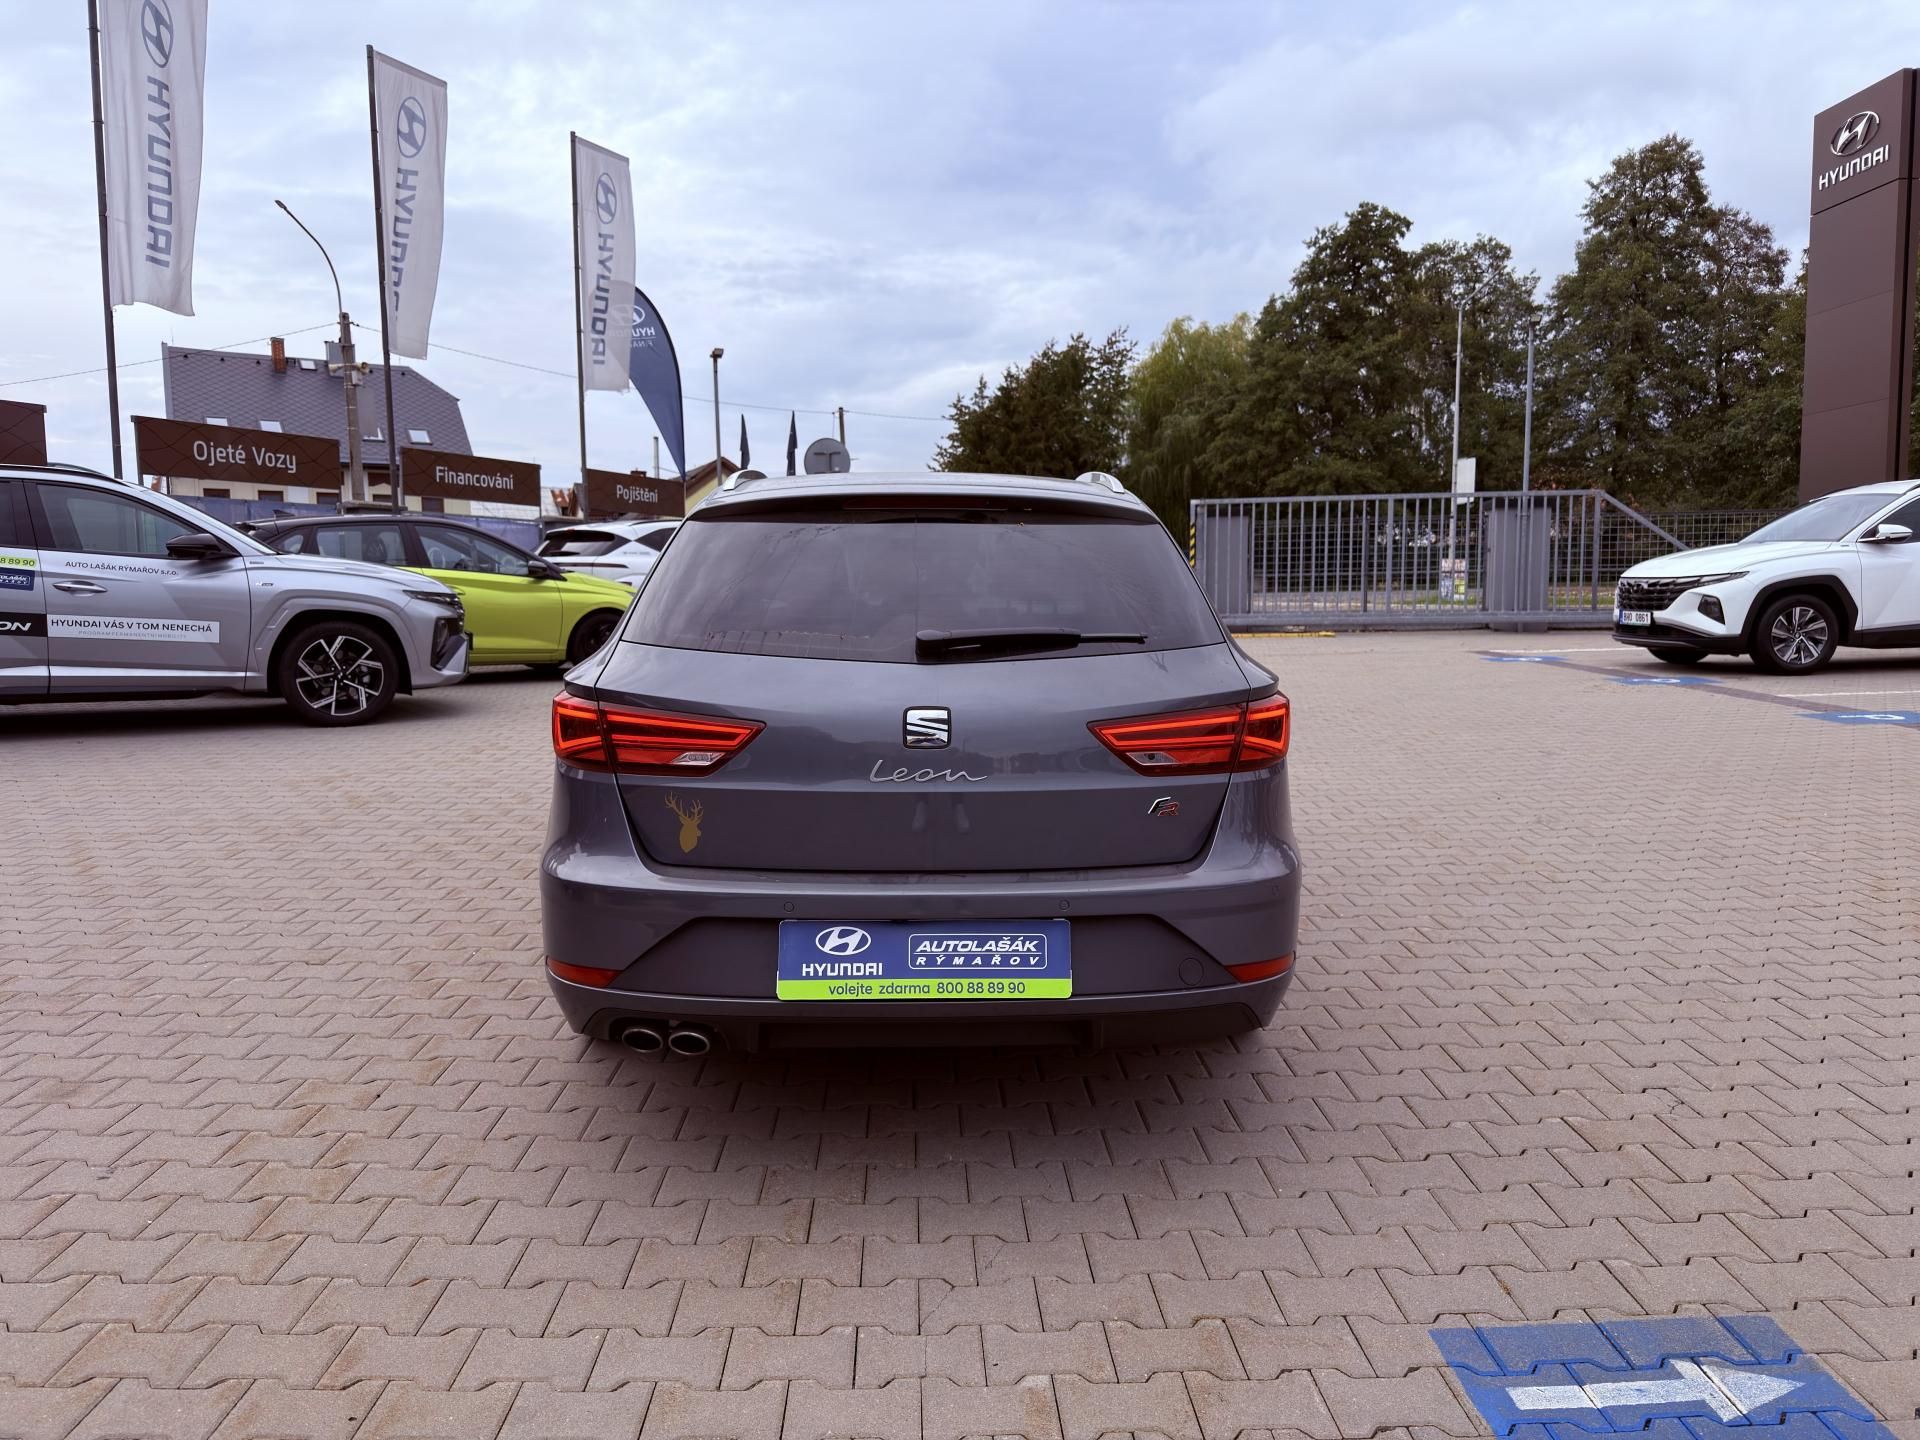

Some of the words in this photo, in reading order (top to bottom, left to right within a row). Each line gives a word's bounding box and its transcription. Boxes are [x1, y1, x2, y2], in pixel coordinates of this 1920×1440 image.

[145, 75, 172, 268] HYUNDAI
[1819, 144, 1889, 190] HYUNDAI
[591, 232, 615, 365] HYUNDAI
[193, 440, 246, 466] Ojeté
[252, 446, 297, 474] Vozy
[435, 466, 514, 490] Financování
[616, 484, 658, 503] Pojištění
[64, 561, 89, 569] AUTO
[90, 562, 117, 571] LAŠÁK
[118, 564, 160, 575] RÝMAŘOV
[51, 619, 101, 628] HYUNDAI
[103, 619, 125, 629] VÁS
[126, 621, 134, 629] V
[136, 622, 160, 631] TOM
[162, 623, 212, 633] NENECHÁ
[869, 759, 988, 782] Leon
[916, 936, 1040, 952] AUTOLAŠÁK
[802, 962, 883, 977] HYUNDAI
[916, 954, 1040, 966] RÝMAŘOV
[828, 983, 873, 997] volejte
[879, 982, 931, 995] zdarma
[936, 982, 964, 994] 800
[967, 982, 985, 994] 88
[987, 982, 1005, 994] 89
[1008, 982, 1026, 994] 90
